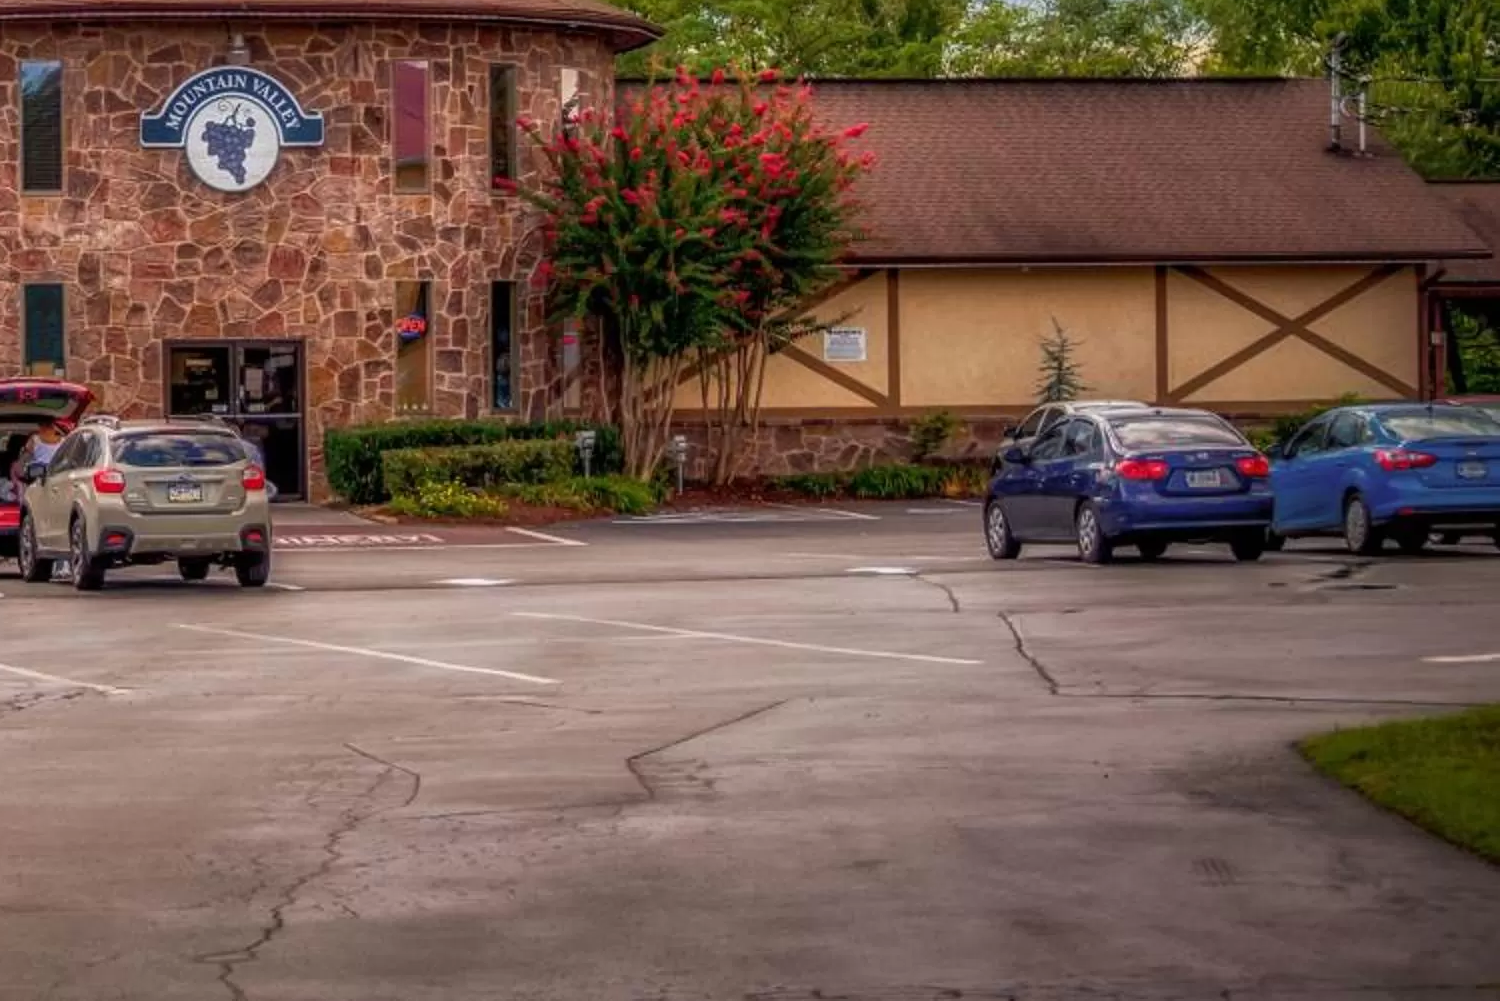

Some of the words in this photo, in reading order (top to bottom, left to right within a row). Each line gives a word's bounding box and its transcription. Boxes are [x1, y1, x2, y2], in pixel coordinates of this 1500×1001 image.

[165, 74, 248, 130] MOUNTAIN
[252, 78, 301, 129] VALLEY
[396, 317, 426, 332] OPEN
